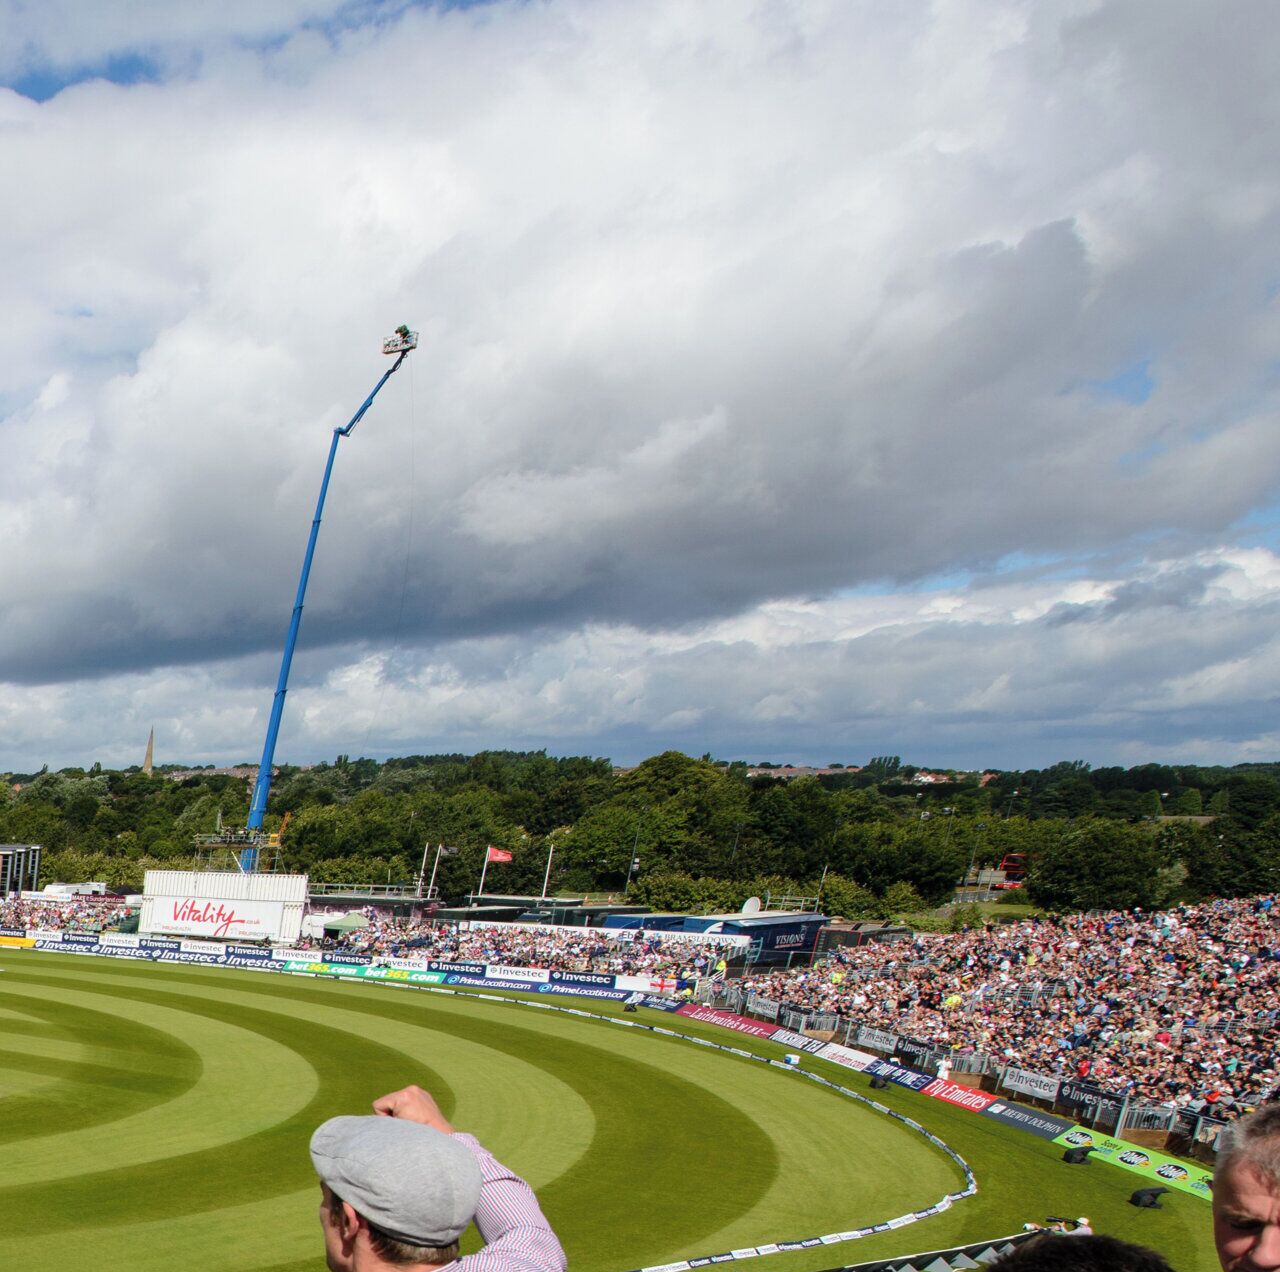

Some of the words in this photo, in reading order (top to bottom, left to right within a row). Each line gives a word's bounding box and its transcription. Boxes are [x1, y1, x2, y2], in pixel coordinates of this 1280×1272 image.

[33, 932, 59, 940] Investec
[69, 934, 97, 943] Investec
[107, 937, 136, 946] Investec
[664, 934, 737, 944] BRAMBLEDOWN
[776, 933, 805, 945] VISIONS
[42, 941, 90, 952] Investec
[147, 940, 179, 948] Investec
[189, 943, 221, 953] Investec
[100, 945, 150, 957] Investec
[161, 951, 215, 963] Investec
[235, 947, 269, 956] Investec
[282, 951, 318, 960] Investec
[227, 956, 284, 969] Investec
[332, 954, 370, 964] Investec
[382, 959, 424, 969] Investec
[288, 961, 356, 975] bet365.com
[439, 963, 483, 974] Investec
[498, 967, 544, 978] Investec
[365, 969, 439, 982] bet365.com
[562, 972, 610, 984] Investec
[459, 976, 531, 990] PrimeLocation.com
[753, 1001, 777, 1014] Investec
[739, 1024, 763, 1036] WINE
[864, 1028, 893, 1046] Investec
[904, 1040, 928, 1054] Invest
[1014, 1071, 1056, 1093] Investec
[926, 1079, 944, 1097] Fly
[942, 1085, 990, 1109] Emirates
[1070, 1088, 1117, 1110] Investec
[1004, 1108, 1031, 1124] BREWIN
[1027, 1116, 1064, 1134] DOLPHIN
